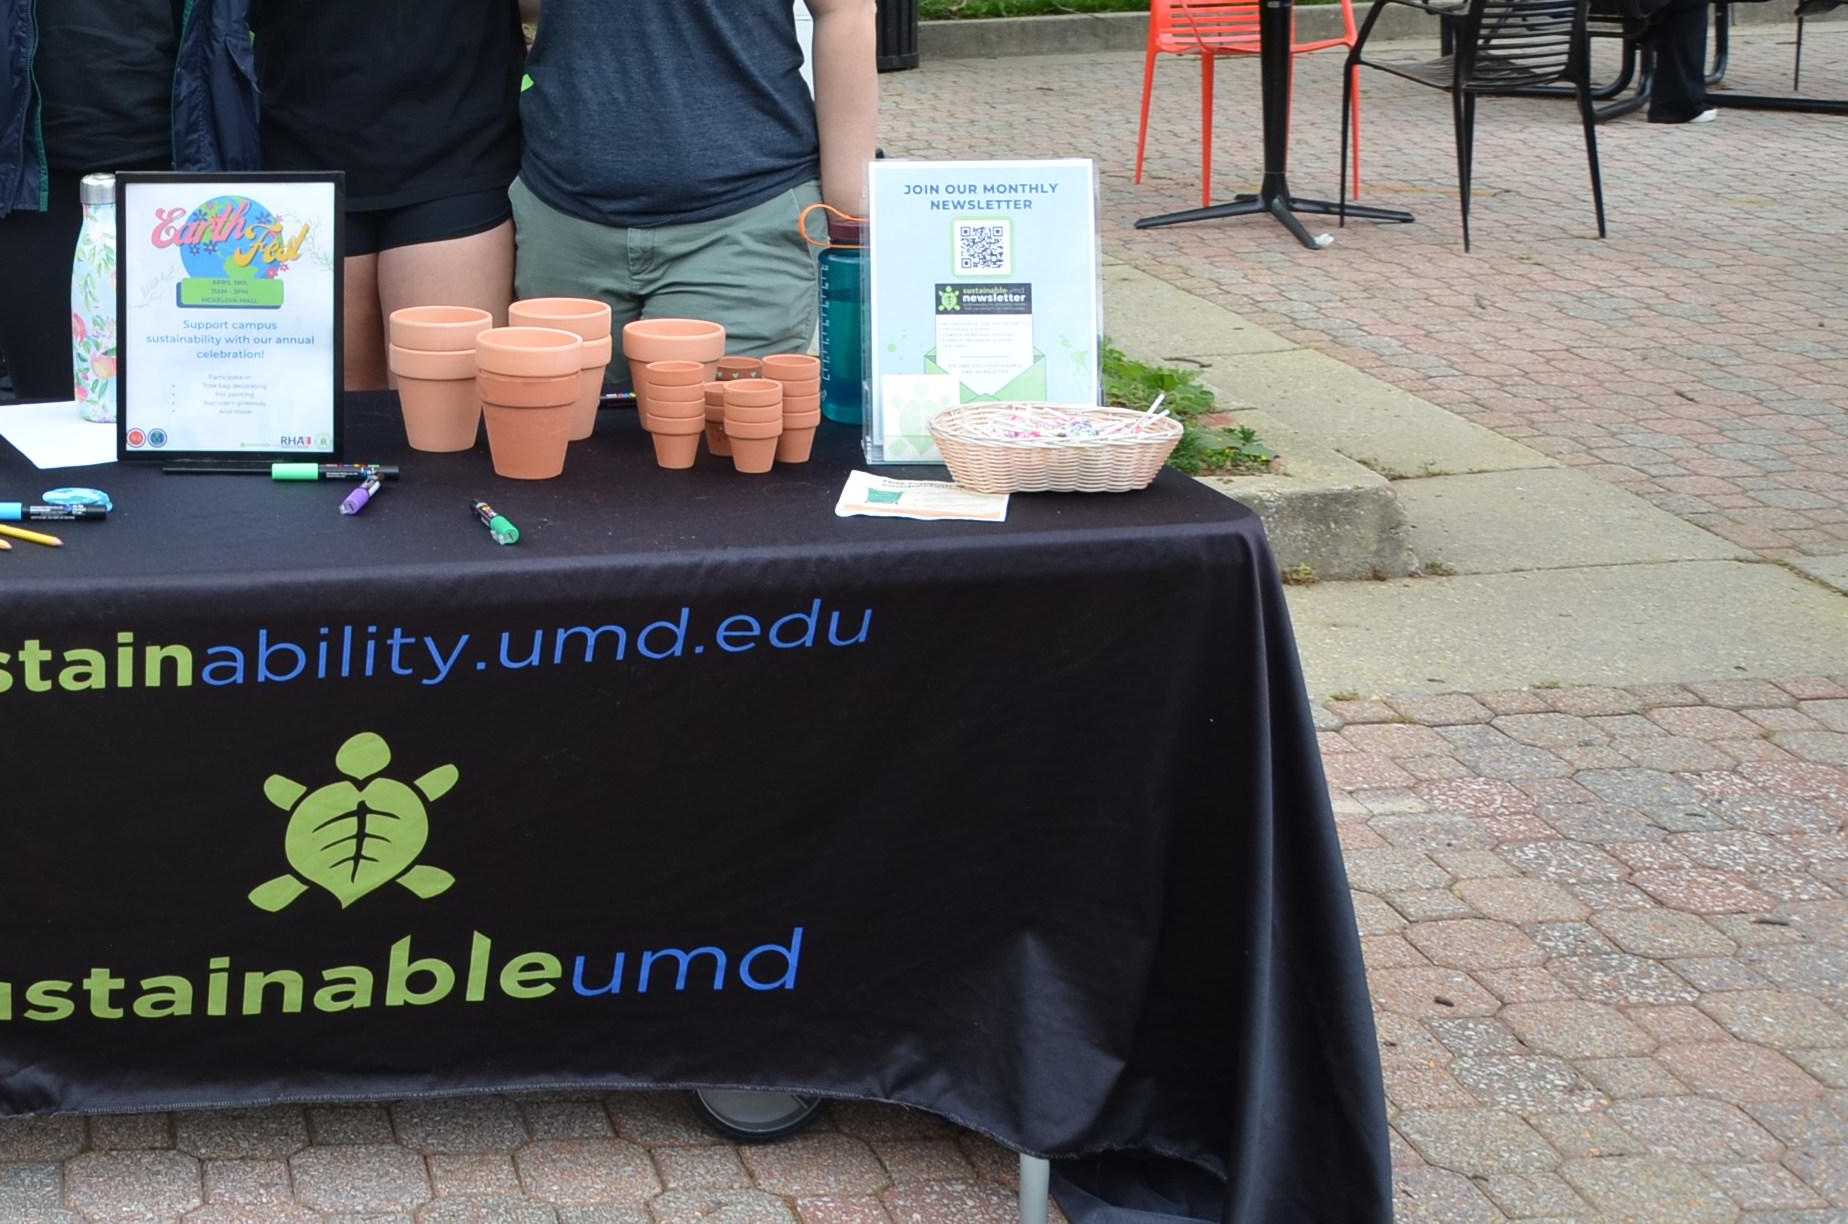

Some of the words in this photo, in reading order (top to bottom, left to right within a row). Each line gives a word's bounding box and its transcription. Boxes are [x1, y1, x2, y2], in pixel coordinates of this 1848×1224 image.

[904, 184, 940, 195] JOIN
[945, 184, 977, 195] OUR
[983, 182, 1059, 195] MONTHLY
[930, 199, 1033, 211] NEWSLETTER
[151, 200, 251, 249] Earth
[233, 222, 310, 268] Fest
[962, 293, 1026, 303] newsletter
[183, 319, 228, 332] Support
[231, 322, 277, 332] campus
[146, 334, 221, 346] sustainability
[224, 334, 250, 345] with
[253, 336, 272, 345] our
[275, 335, 315, 345] annual
[196, 349, 265, 359] celebration!
[280, 435, 305, 447] RHA
